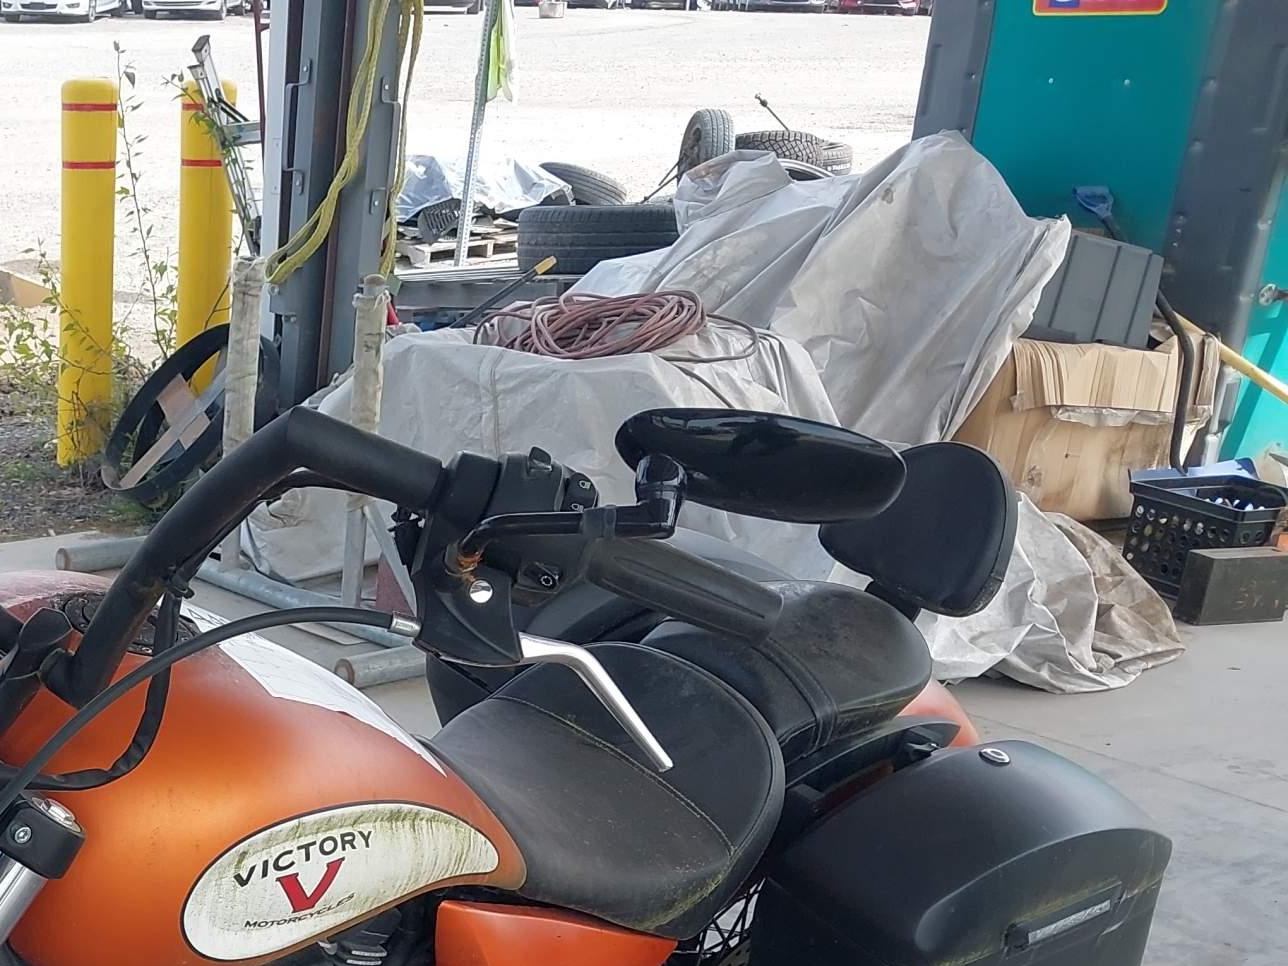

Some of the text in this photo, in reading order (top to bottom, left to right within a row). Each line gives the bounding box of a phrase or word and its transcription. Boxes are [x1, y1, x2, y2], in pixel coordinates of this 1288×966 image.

[233, 831, 373, 888] VICTORY
[275, 856, 346, 914] V
[244, 892, 356, 929] MOTORCYCLES
